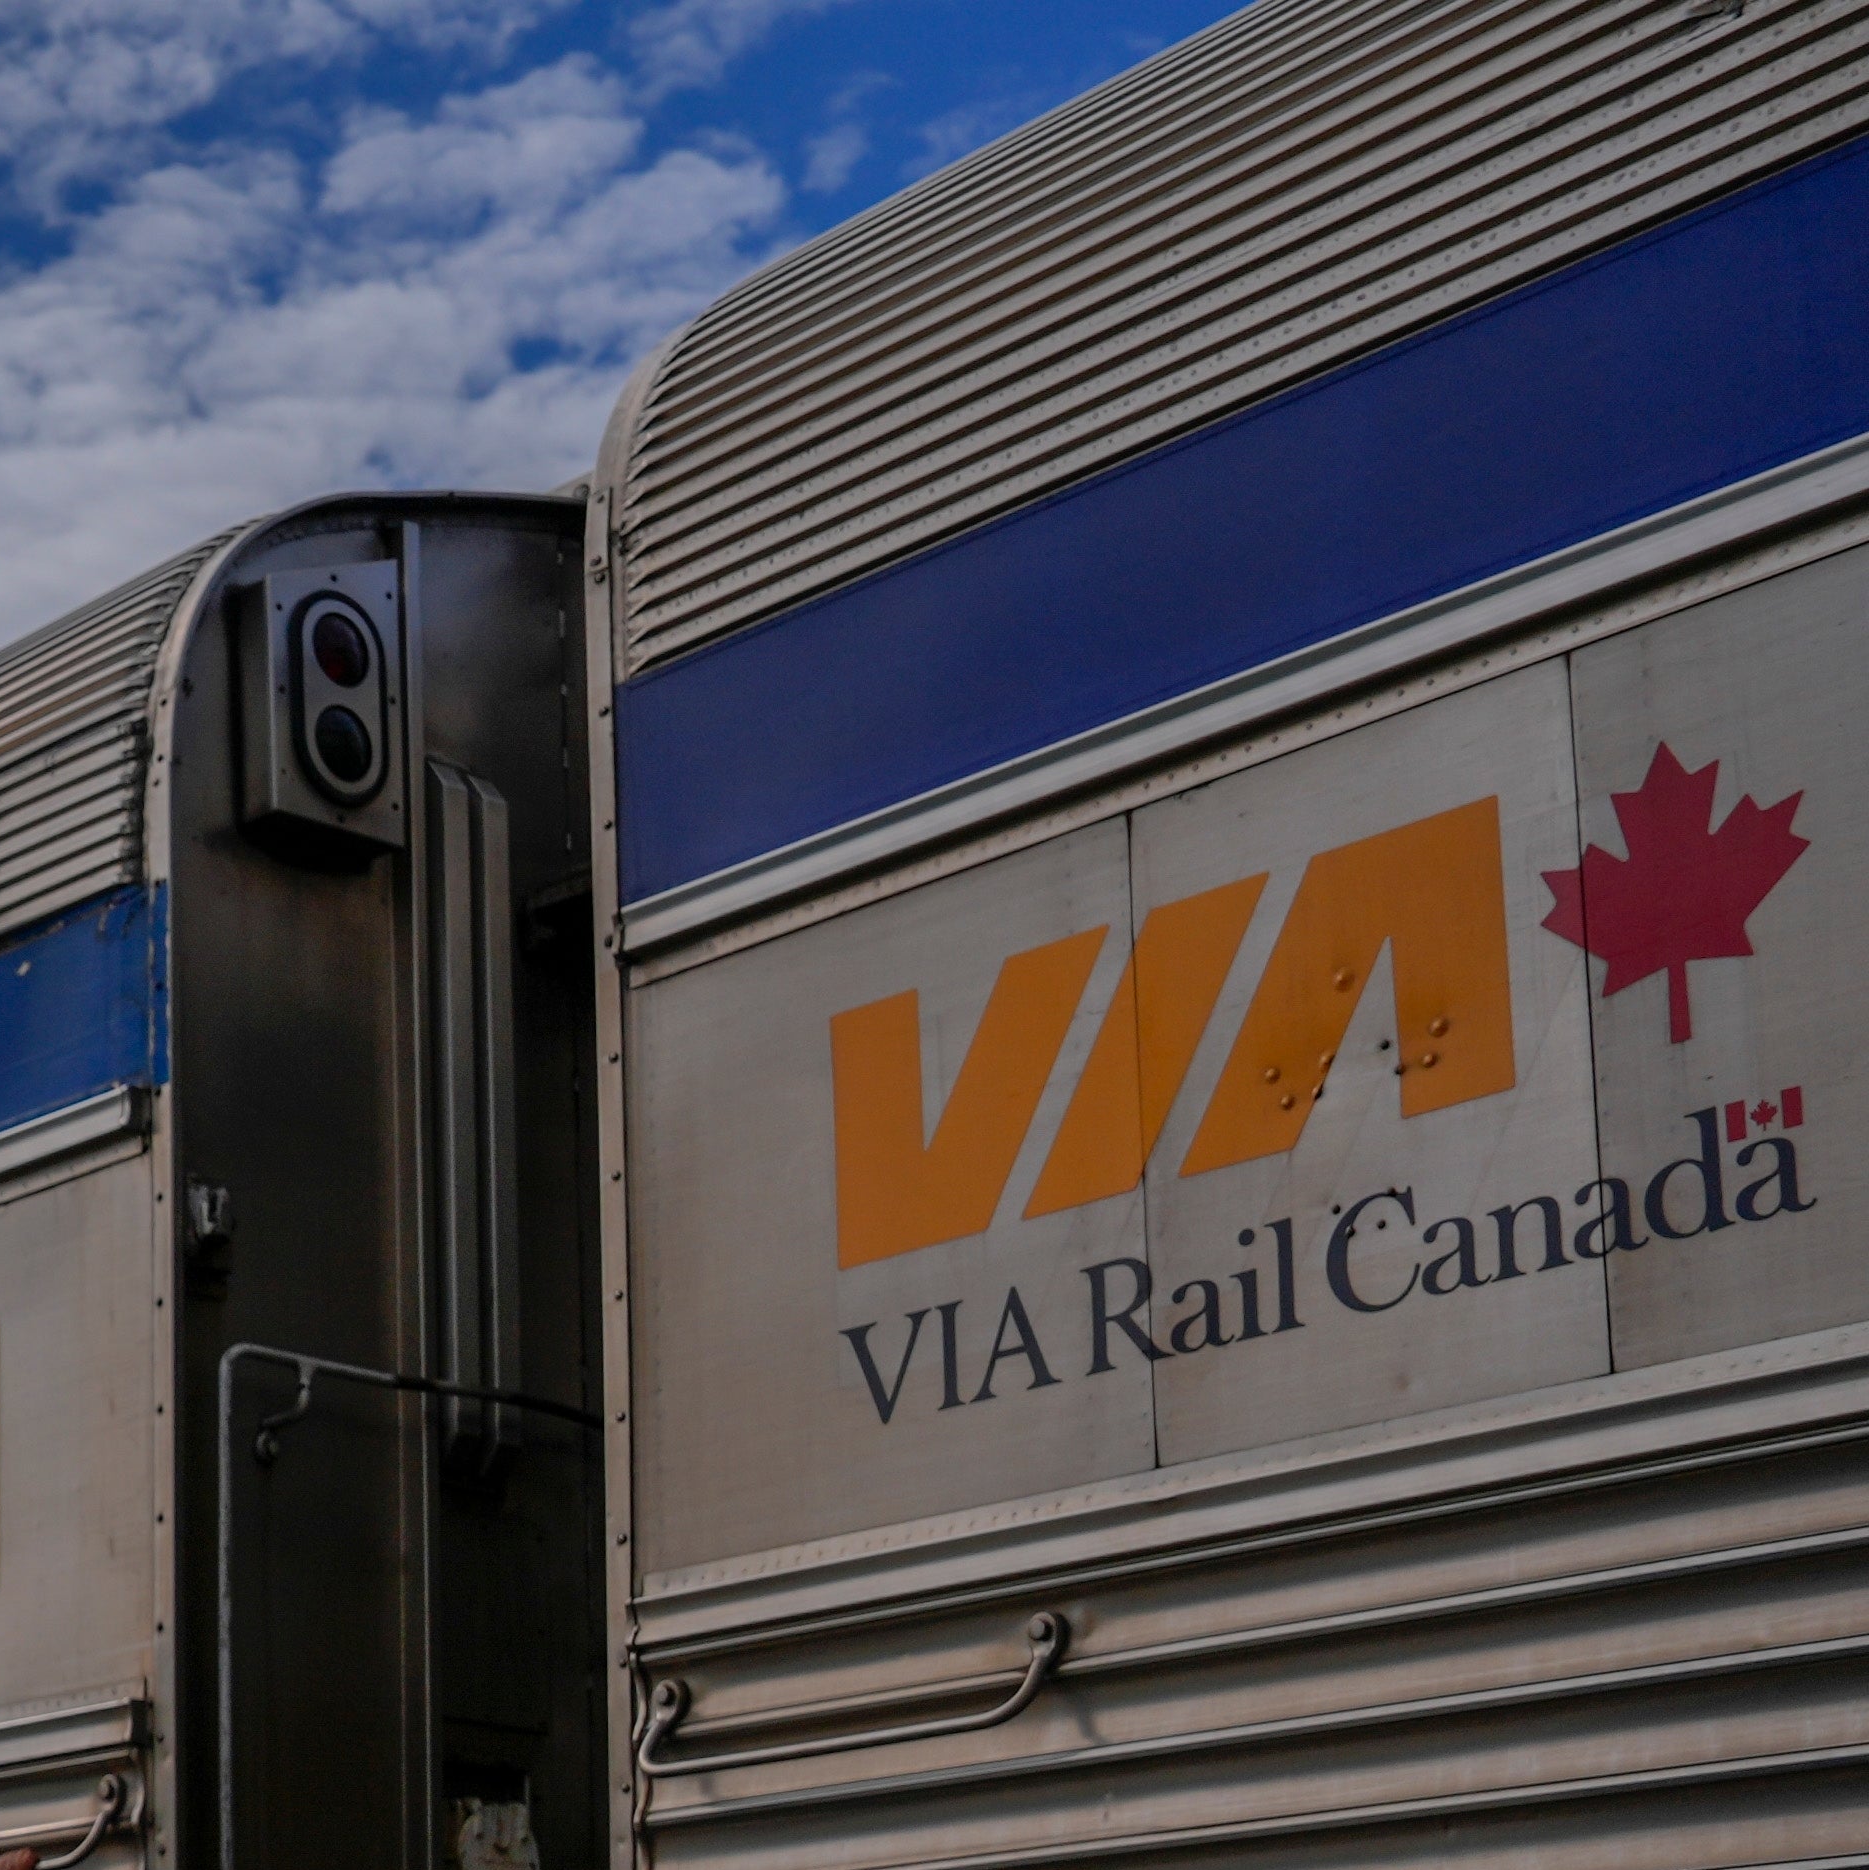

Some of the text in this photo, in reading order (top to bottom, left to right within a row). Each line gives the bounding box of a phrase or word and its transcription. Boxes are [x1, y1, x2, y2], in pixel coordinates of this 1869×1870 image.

[830, 795, 1514, 1270] VIA
[839, 1107, 1816, 1425] VIA Rail Canada
